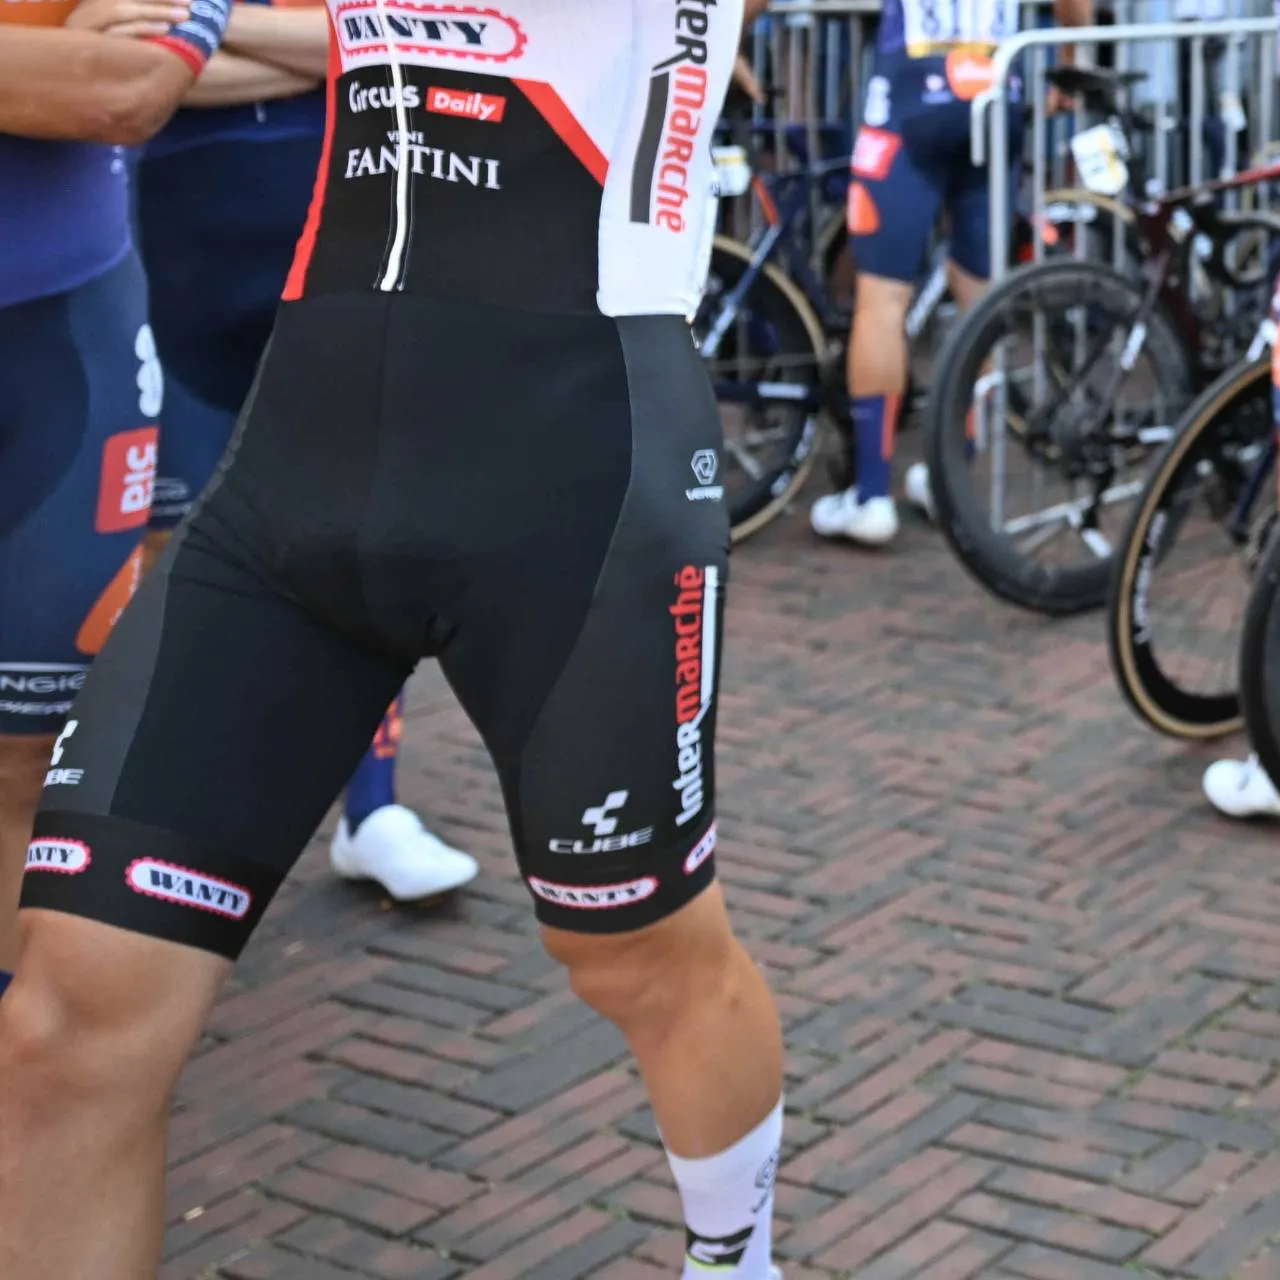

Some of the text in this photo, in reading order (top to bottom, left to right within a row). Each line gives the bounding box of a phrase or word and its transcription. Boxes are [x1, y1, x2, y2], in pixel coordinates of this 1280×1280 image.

[343, 14, 489, 47] WANTY
[349, 80, 498, 121] Circus Daily
[344, 144, 503, 190] FANTINI
[44, 768, 84, 787] BE
[549, 825, 656, 855] CUBE
[149, 868, 244, 911] WANTY
[539, 883, 641, 907] WANTY
